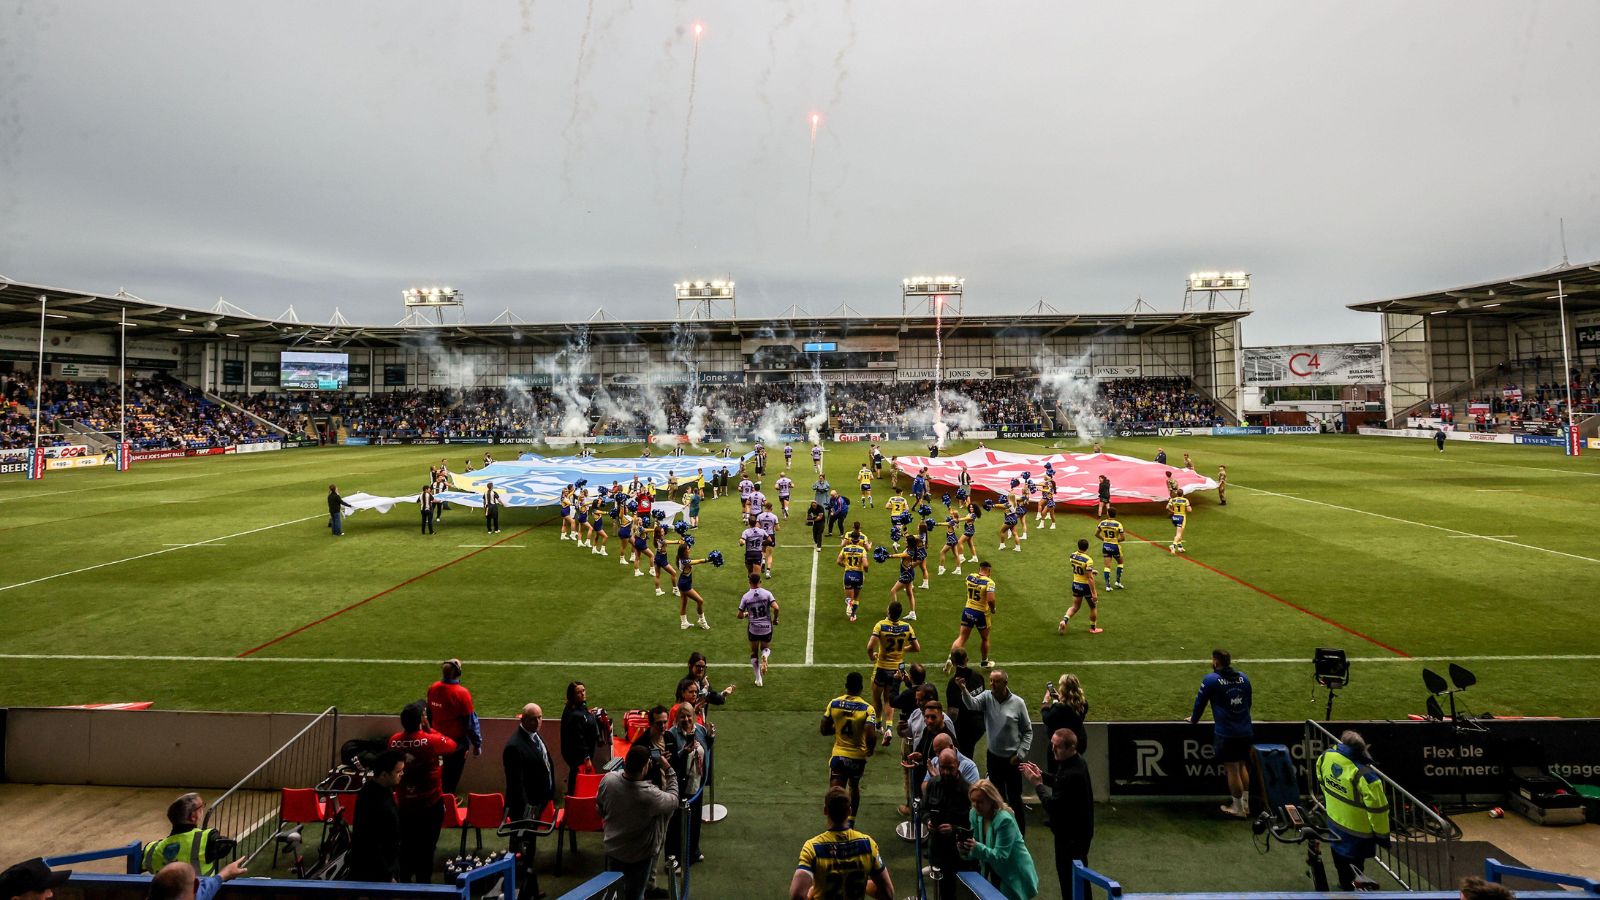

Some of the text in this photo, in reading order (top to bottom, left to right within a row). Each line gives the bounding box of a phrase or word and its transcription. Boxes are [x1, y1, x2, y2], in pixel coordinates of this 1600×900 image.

[702, 373, 728, 382] Jones
[949, 370, 971, 378] JONES
[1, 462, 28, 473] BEER
[968, 588, 981, 601] 15
[391, 738, 427, 748] DOCTOR
[1423, 745, 1484, 759] Flexble
